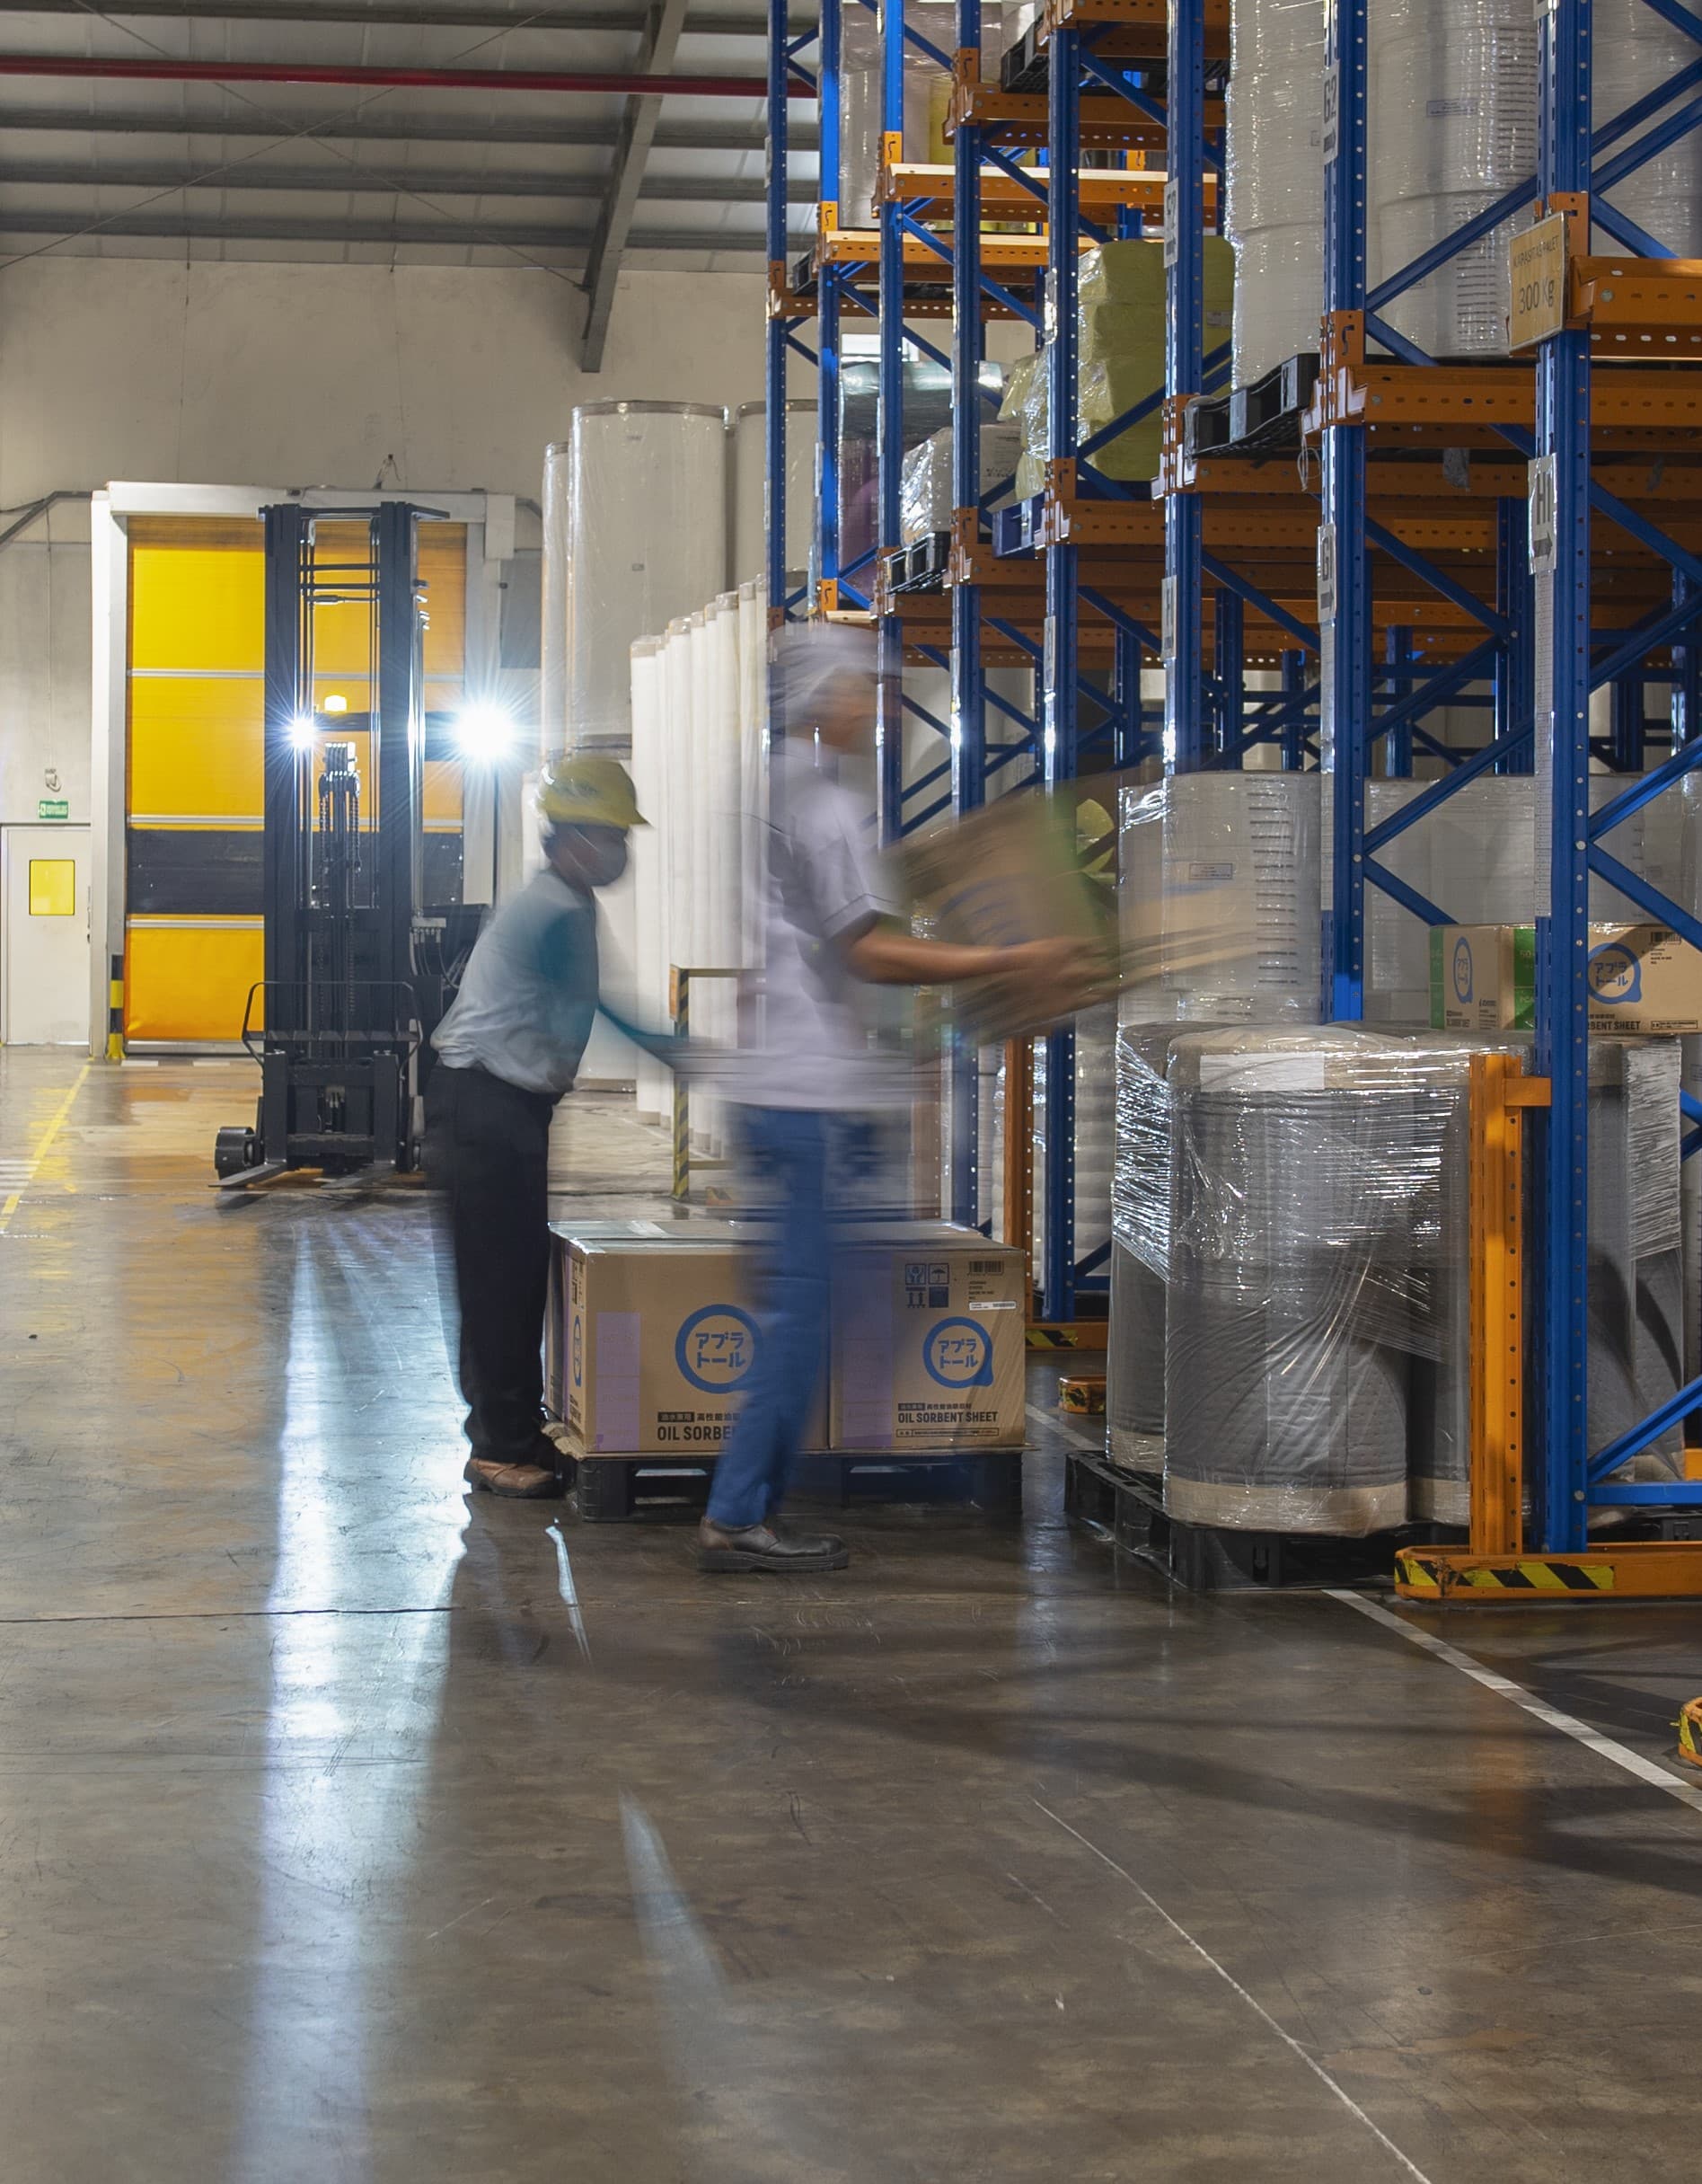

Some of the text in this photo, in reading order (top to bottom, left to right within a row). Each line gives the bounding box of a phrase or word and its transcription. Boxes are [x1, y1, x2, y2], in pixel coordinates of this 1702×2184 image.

[1324, 75, 1336, 124] G2
[1519, 278, 1555, 314] 300 Kg
[1594, 975, 1629, 986] トール
[1614, 1021, 1641, 1030] SHEET
[695, 1331, 745, 1349] アブラ
[939, 1339, 977, 1354] アブラ
[696, 1351, 745, 1369] トール
[940, 1355, 978, 1369] トール
[898, 1411, 999, 1423] OIL SORBENT SHEET
[657, 1426, 732, 1441] OIL SORBE
